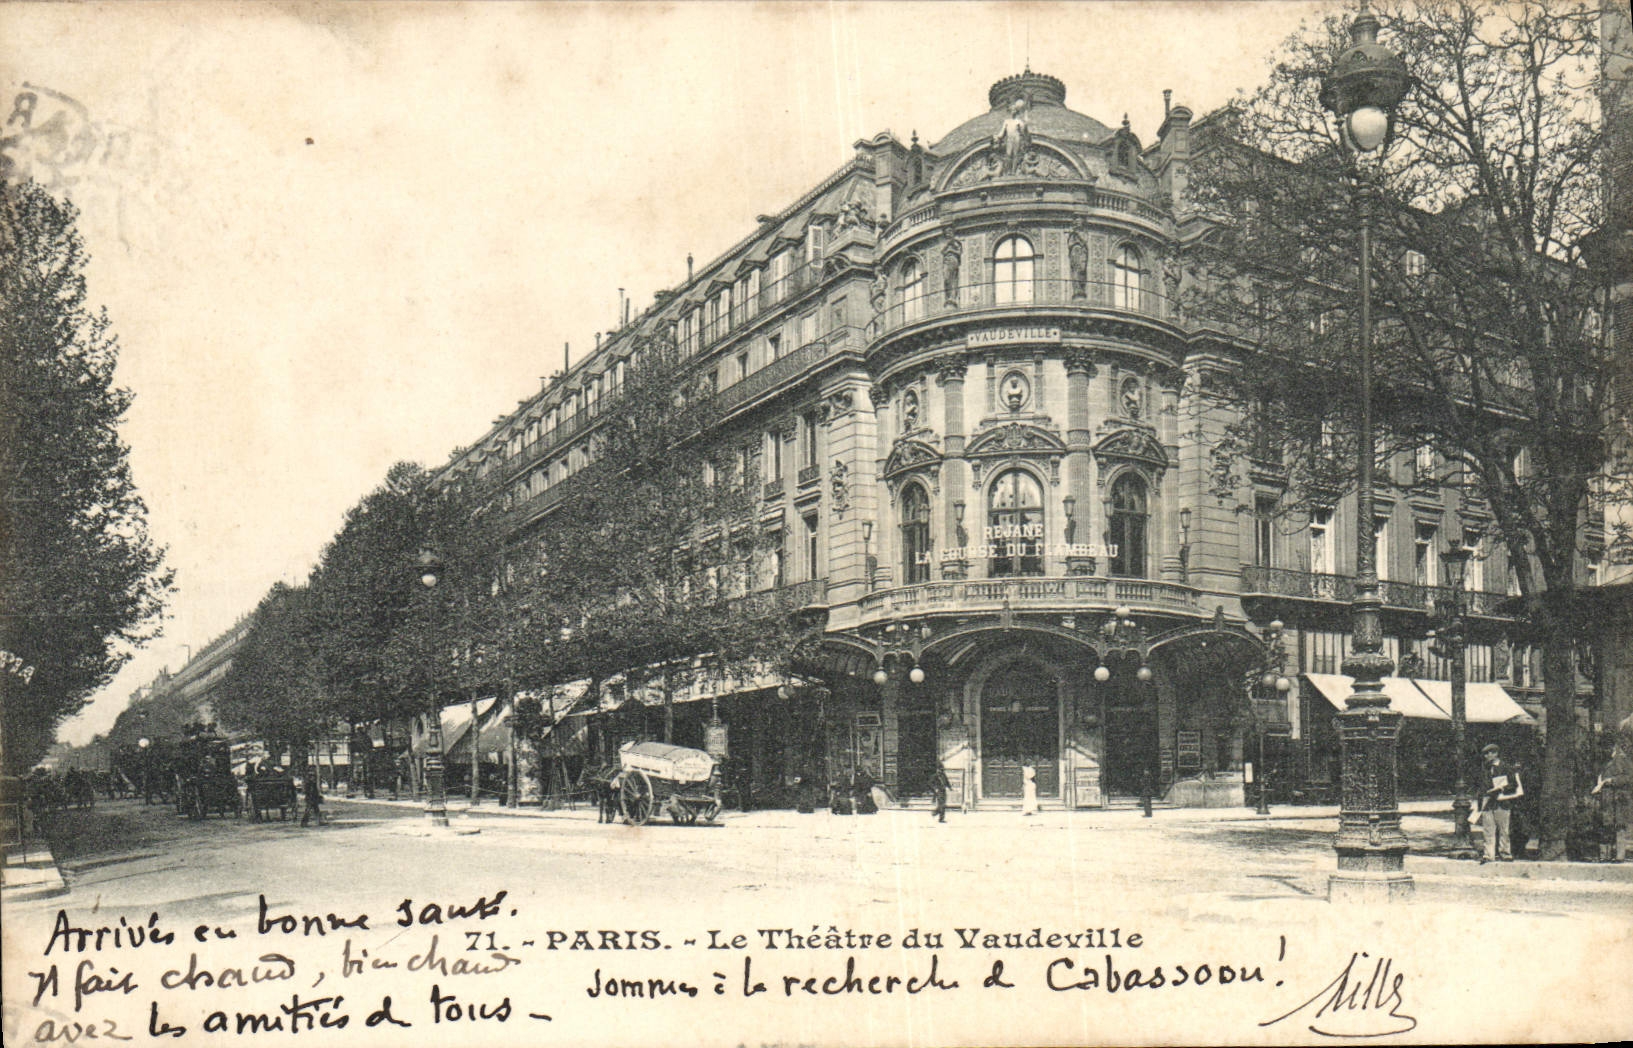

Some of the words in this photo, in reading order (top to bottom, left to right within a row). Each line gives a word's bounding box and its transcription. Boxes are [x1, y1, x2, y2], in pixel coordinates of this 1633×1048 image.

[974, 327, 1052, 342] VAUDEVILLE
[915, 551, 931, 565] LA
[1006, 543, 1027, 558] DU
[194, 926, 236, 942] en
[258, 895, 369, 936] bonne
[75, 960, 138, 1012] fait
[744, 957, 766, 996] la
[783, 955, 958, 996] recherche
[149, 1002, 186, 1037] les
[204, 995, 349, 1034] amitiés
[431, 985, 511, 1023] tous
